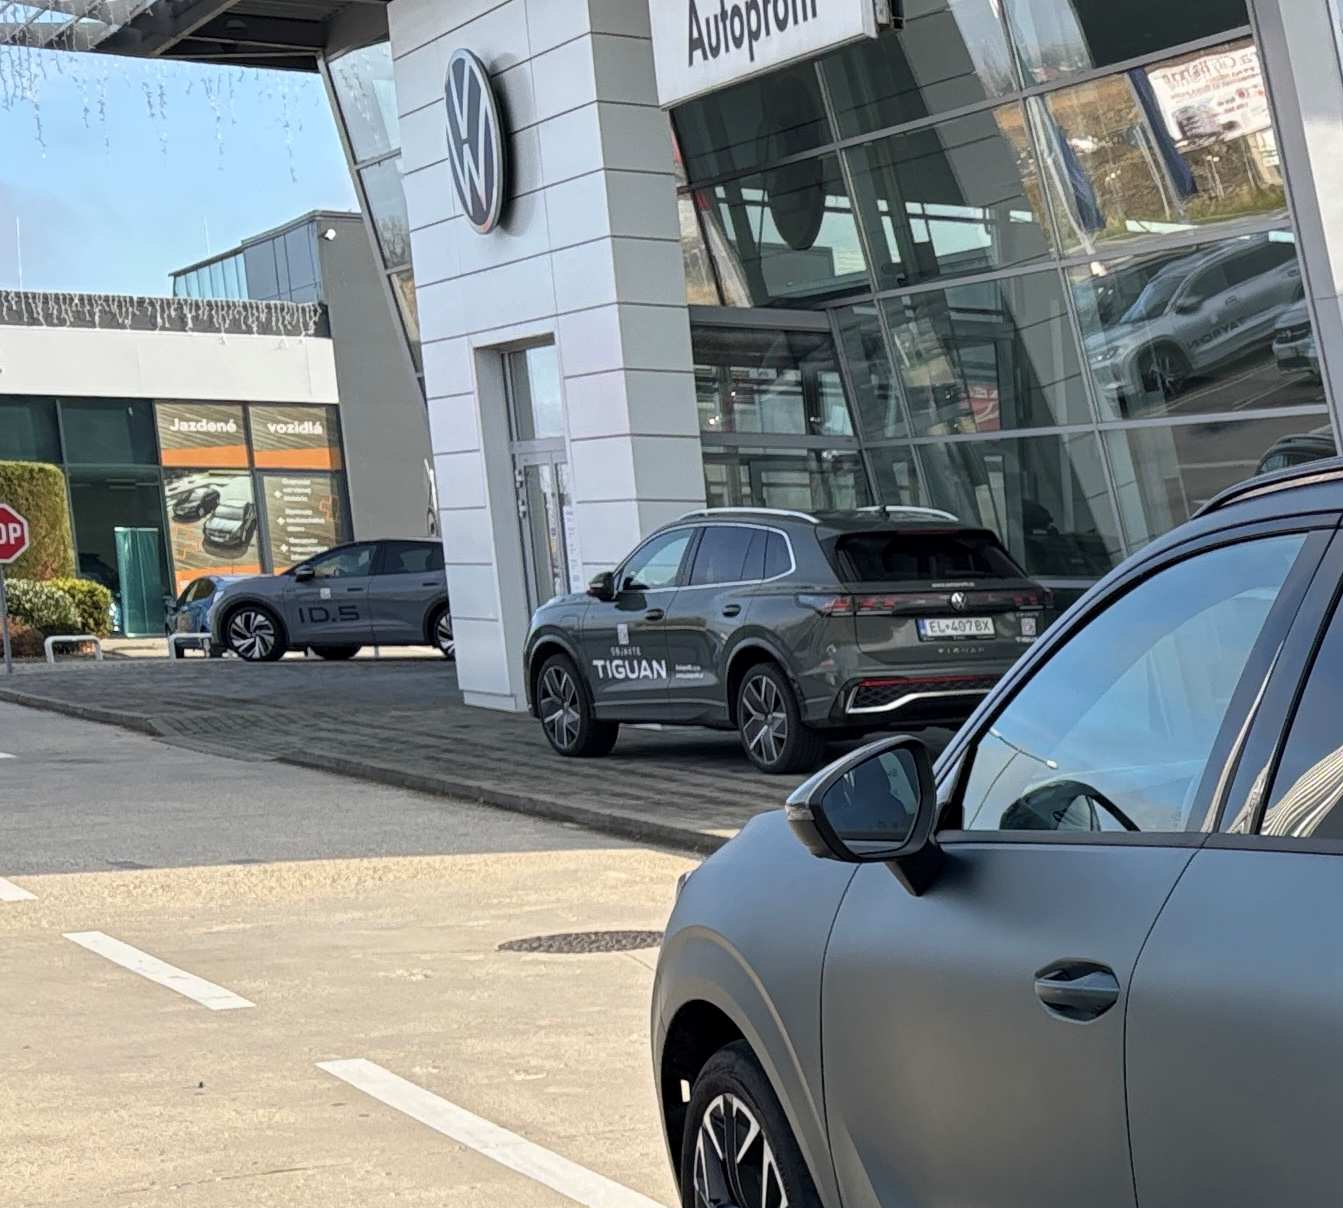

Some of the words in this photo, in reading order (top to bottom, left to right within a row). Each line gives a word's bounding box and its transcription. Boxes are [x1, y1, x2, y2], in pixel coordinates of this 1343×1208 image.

[170, 418, 237, 433] Jazdené
[267, 421, 323, 435] vozidlá
[299, 605, 360, 623] ID.5
[592, 659, 667, 680] TIGUAN
